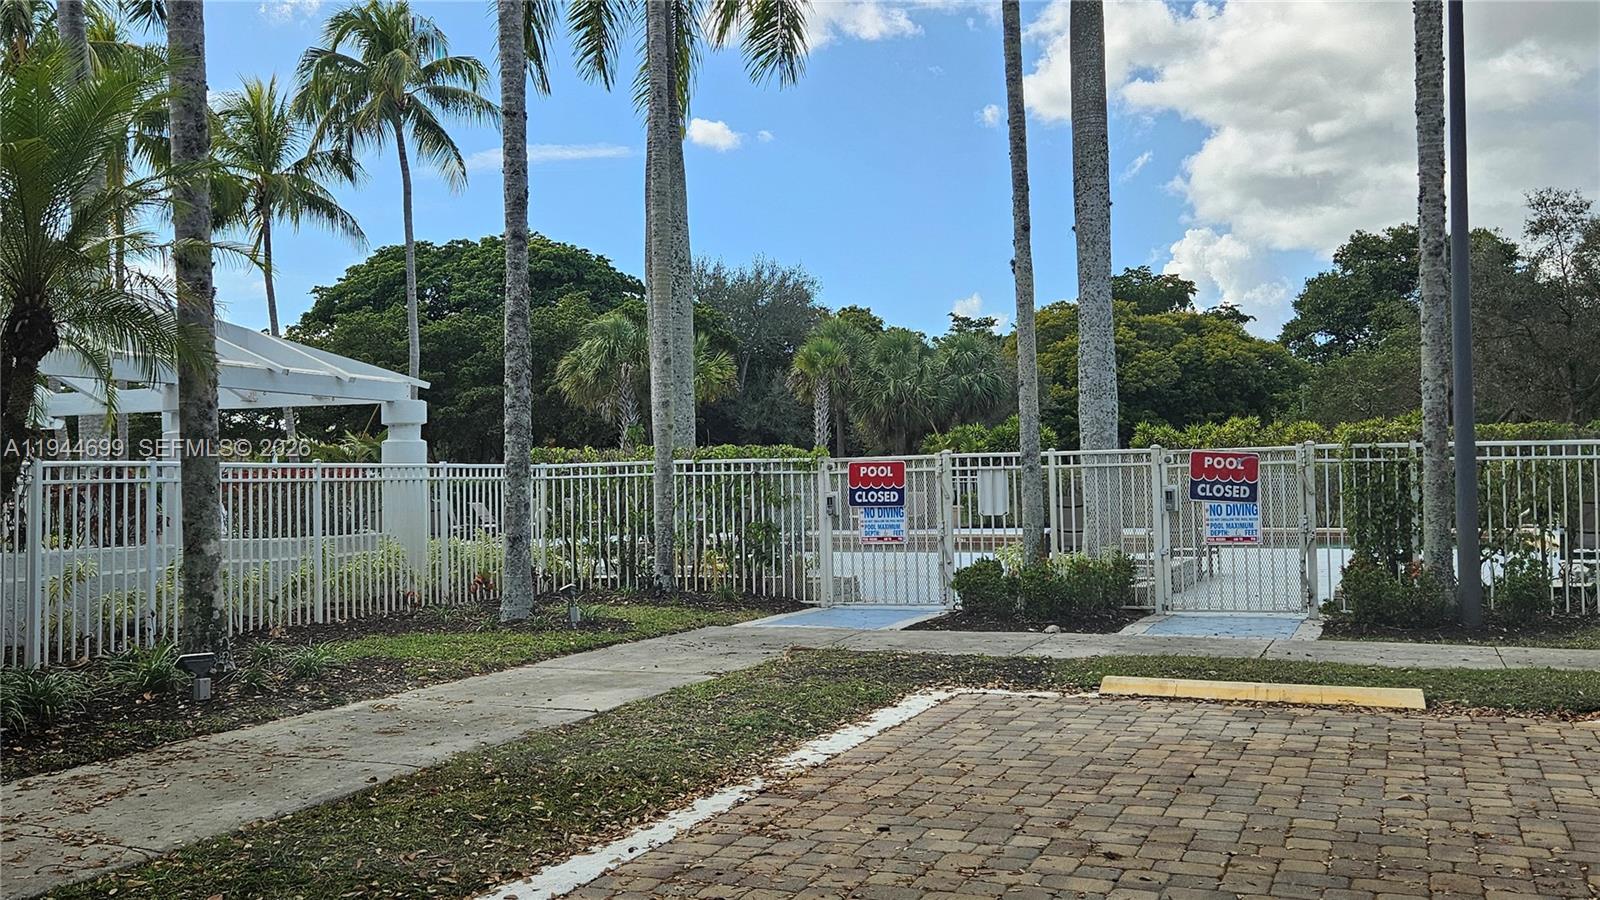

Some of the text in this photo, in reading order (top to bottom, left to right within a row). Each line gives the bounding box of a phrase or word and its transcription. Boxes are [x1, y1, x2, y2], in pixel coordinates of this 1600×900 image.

[1204, 457, 1245, 470] POOL
[860, 466, 893, 477] POOL
[1197, 483, 1250, 498] CLOSED
[855, 491, 899, 503] CLOSED
[864, 507, 904, 518] NO DIVING
[1209, 504, 1258, 516] NO DIVING
